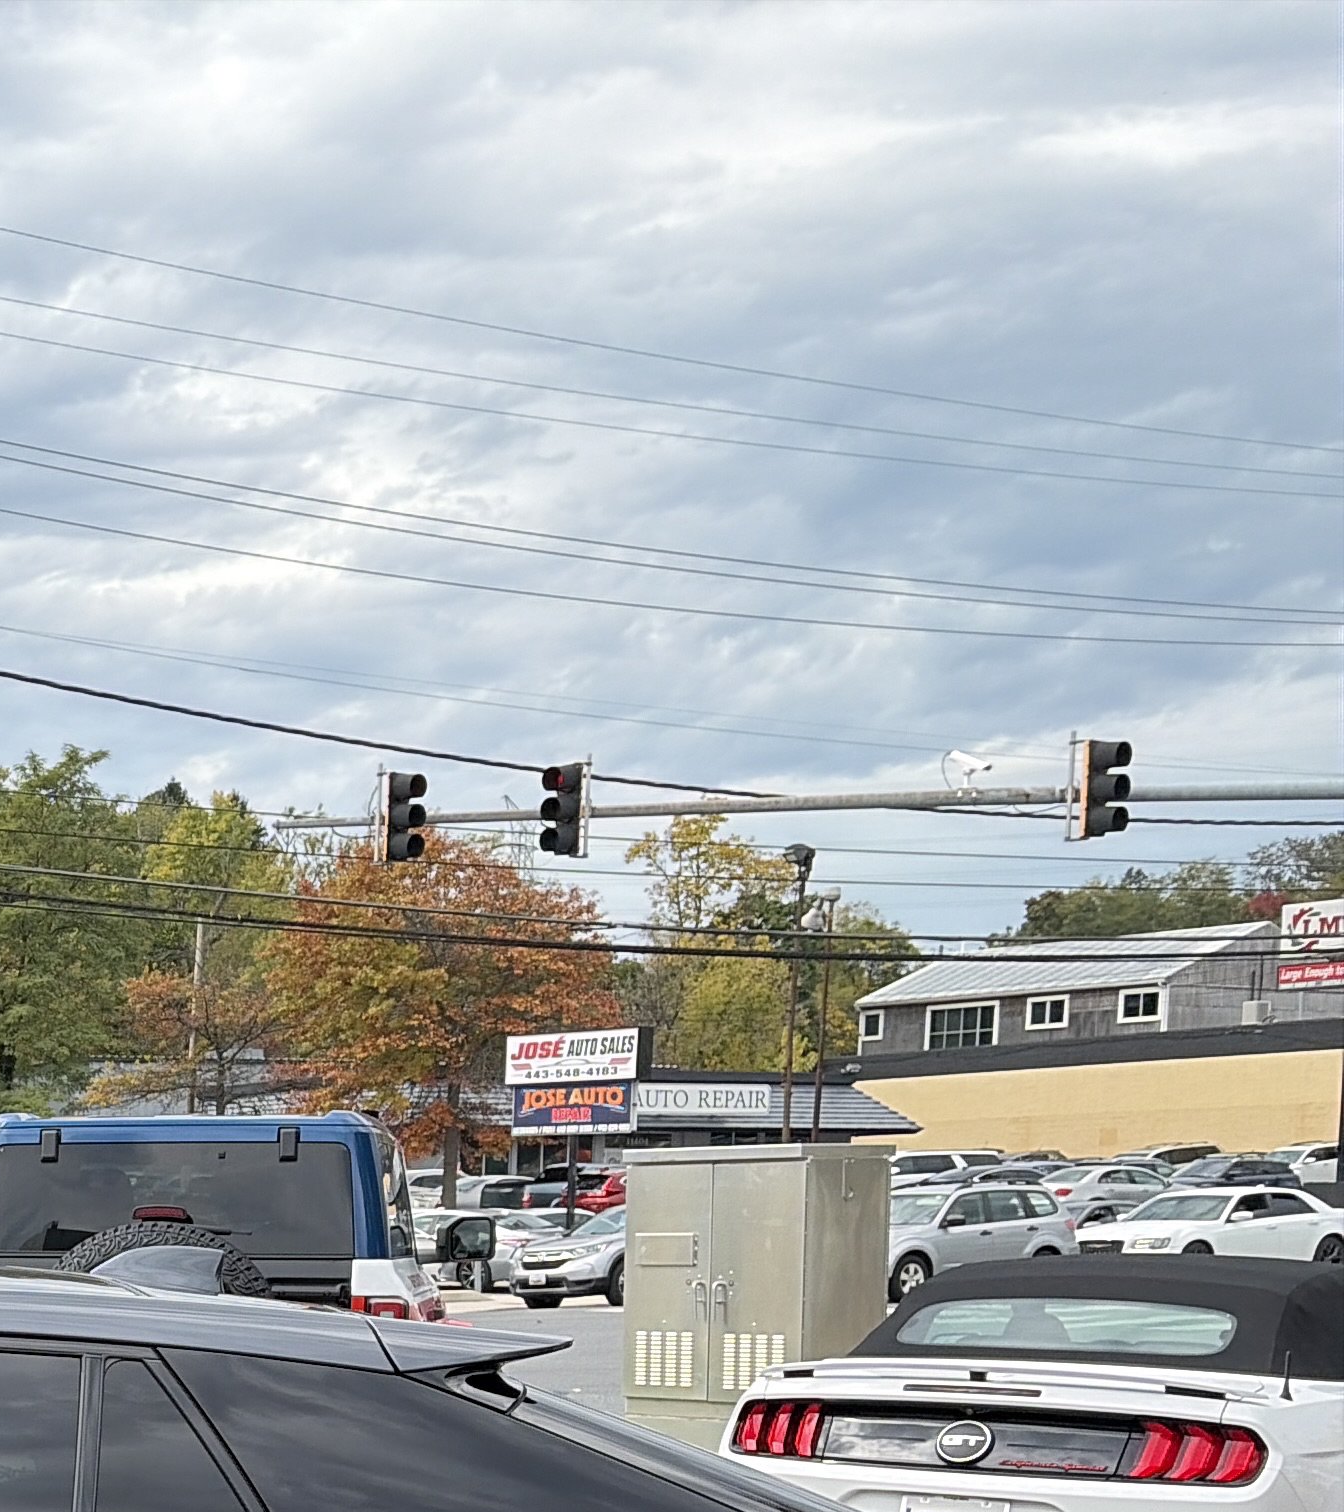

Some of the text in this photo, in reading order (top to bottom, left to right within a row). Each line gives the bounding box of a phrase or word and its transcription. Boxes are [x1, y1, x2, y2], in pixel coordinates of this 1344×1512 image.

[511, 1035, 635, 1060] JOSÉ AUTO SALES
[524, 1066, 618, 1079] 443-548-4183
[522, 1086, 625, 1112] JOSE AUTO
[698, 1089, 768, 1109] REPAIR
